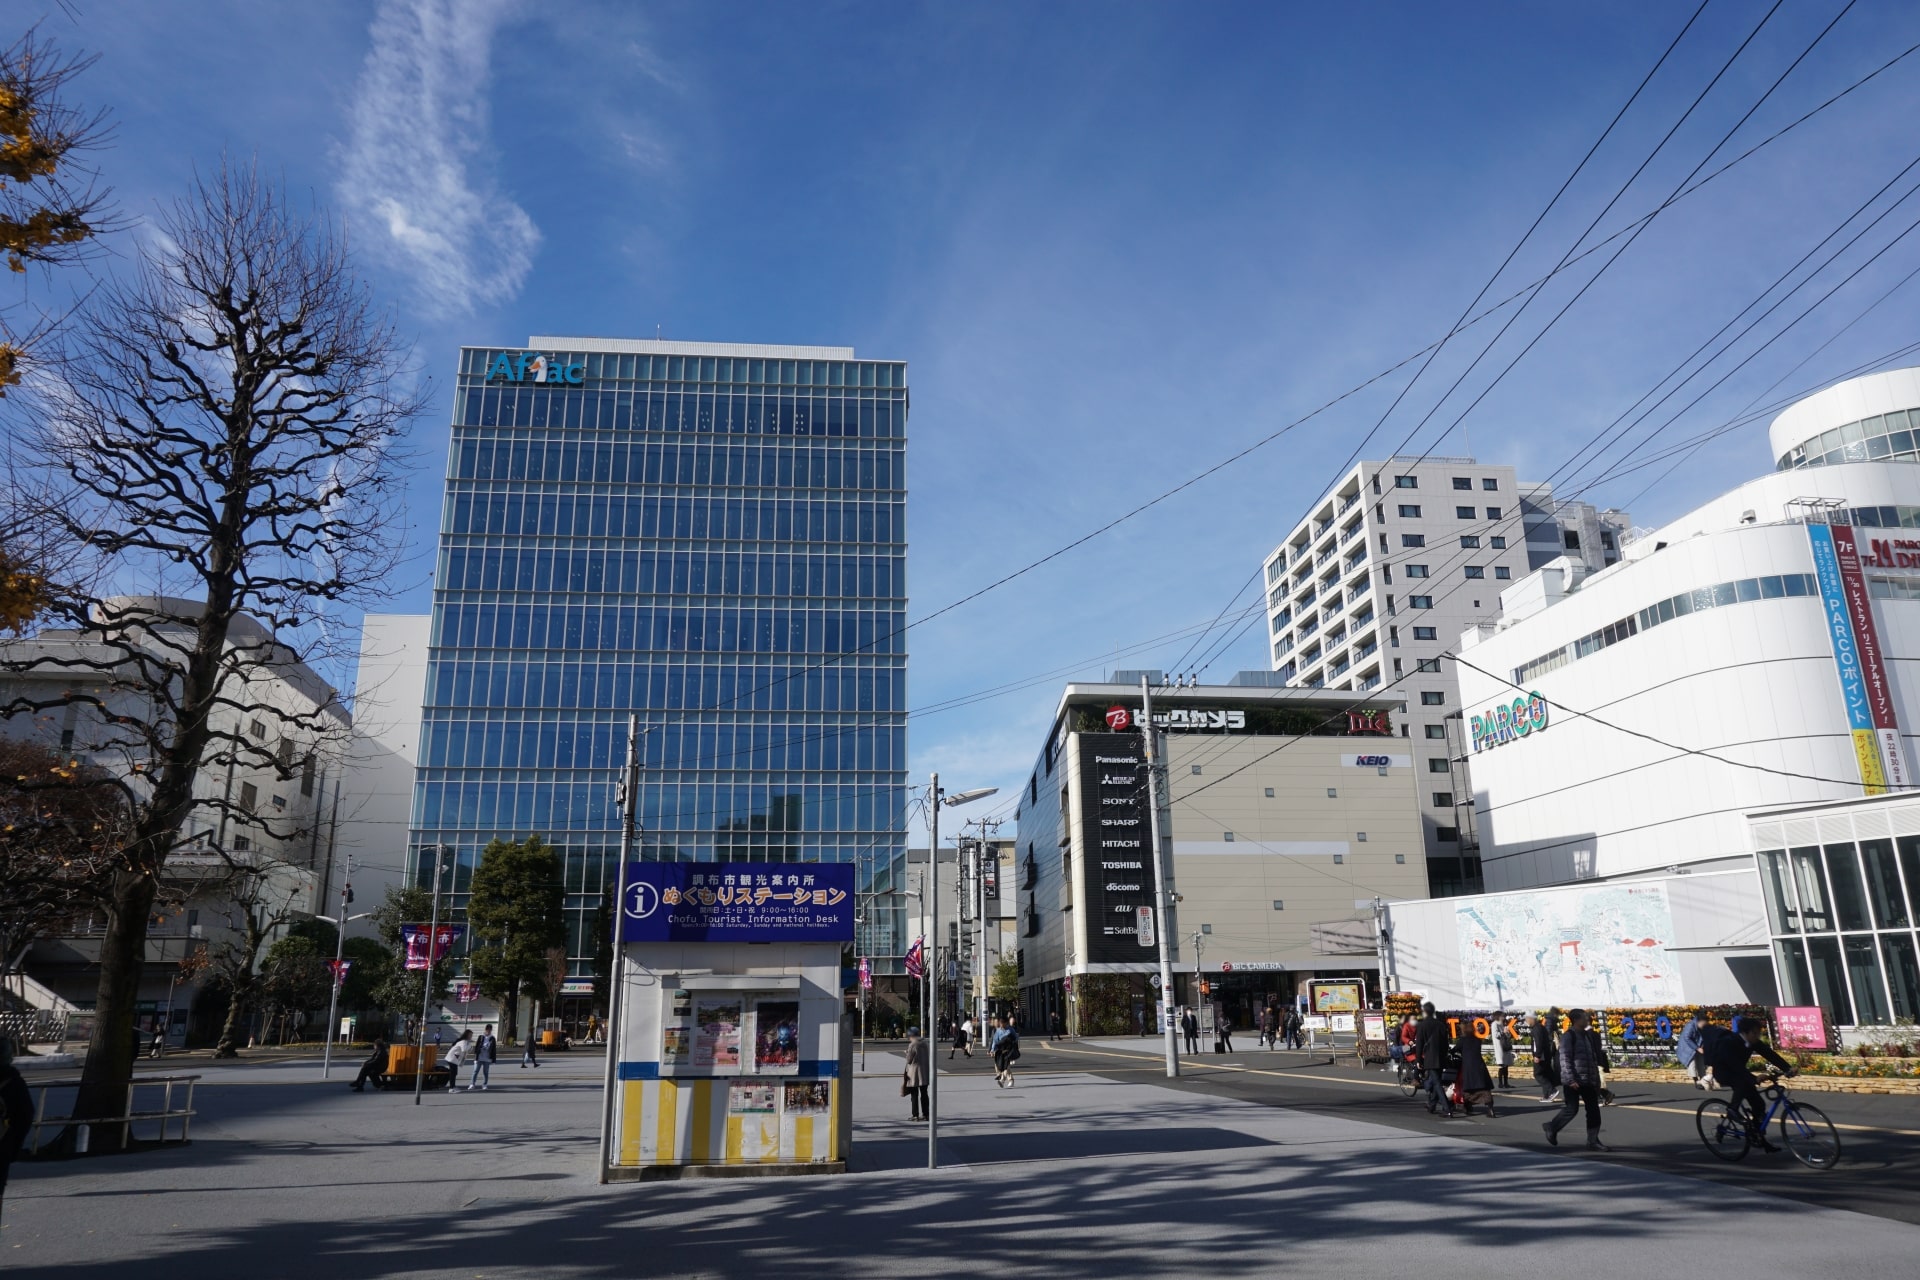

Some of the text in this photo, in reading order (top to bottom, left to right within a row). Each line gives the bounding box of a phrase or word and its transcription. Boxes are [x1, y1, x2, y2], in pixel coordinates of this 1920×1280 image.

[1838, 541, 1853, 552] 7F
[1853, 589, 1868, 630] レストラン
[1829, 599, 1866, 723] PARCOポイント
[1469, 689, 1546, 752] PARCO
[1095, 755, 1138, 764] Panasonic
[1356, 755, 1389, 766] KEIO
[1102, 840, 1140, 848] HITACHI
[1102, 861, 1142, 869] TOSHIBA
[692, 874, 815, 886] 調布市観光案内所
[1106, 882, 1140, 891] docomo
[662, 886, 847, 906] ぬくもりステーション
[668, 914, 839, 923] Chofu Tourist Information Desk
[1114, 927, 1139, 935] SoftBa
[1248, 962, 1283, 970] CAMERA
